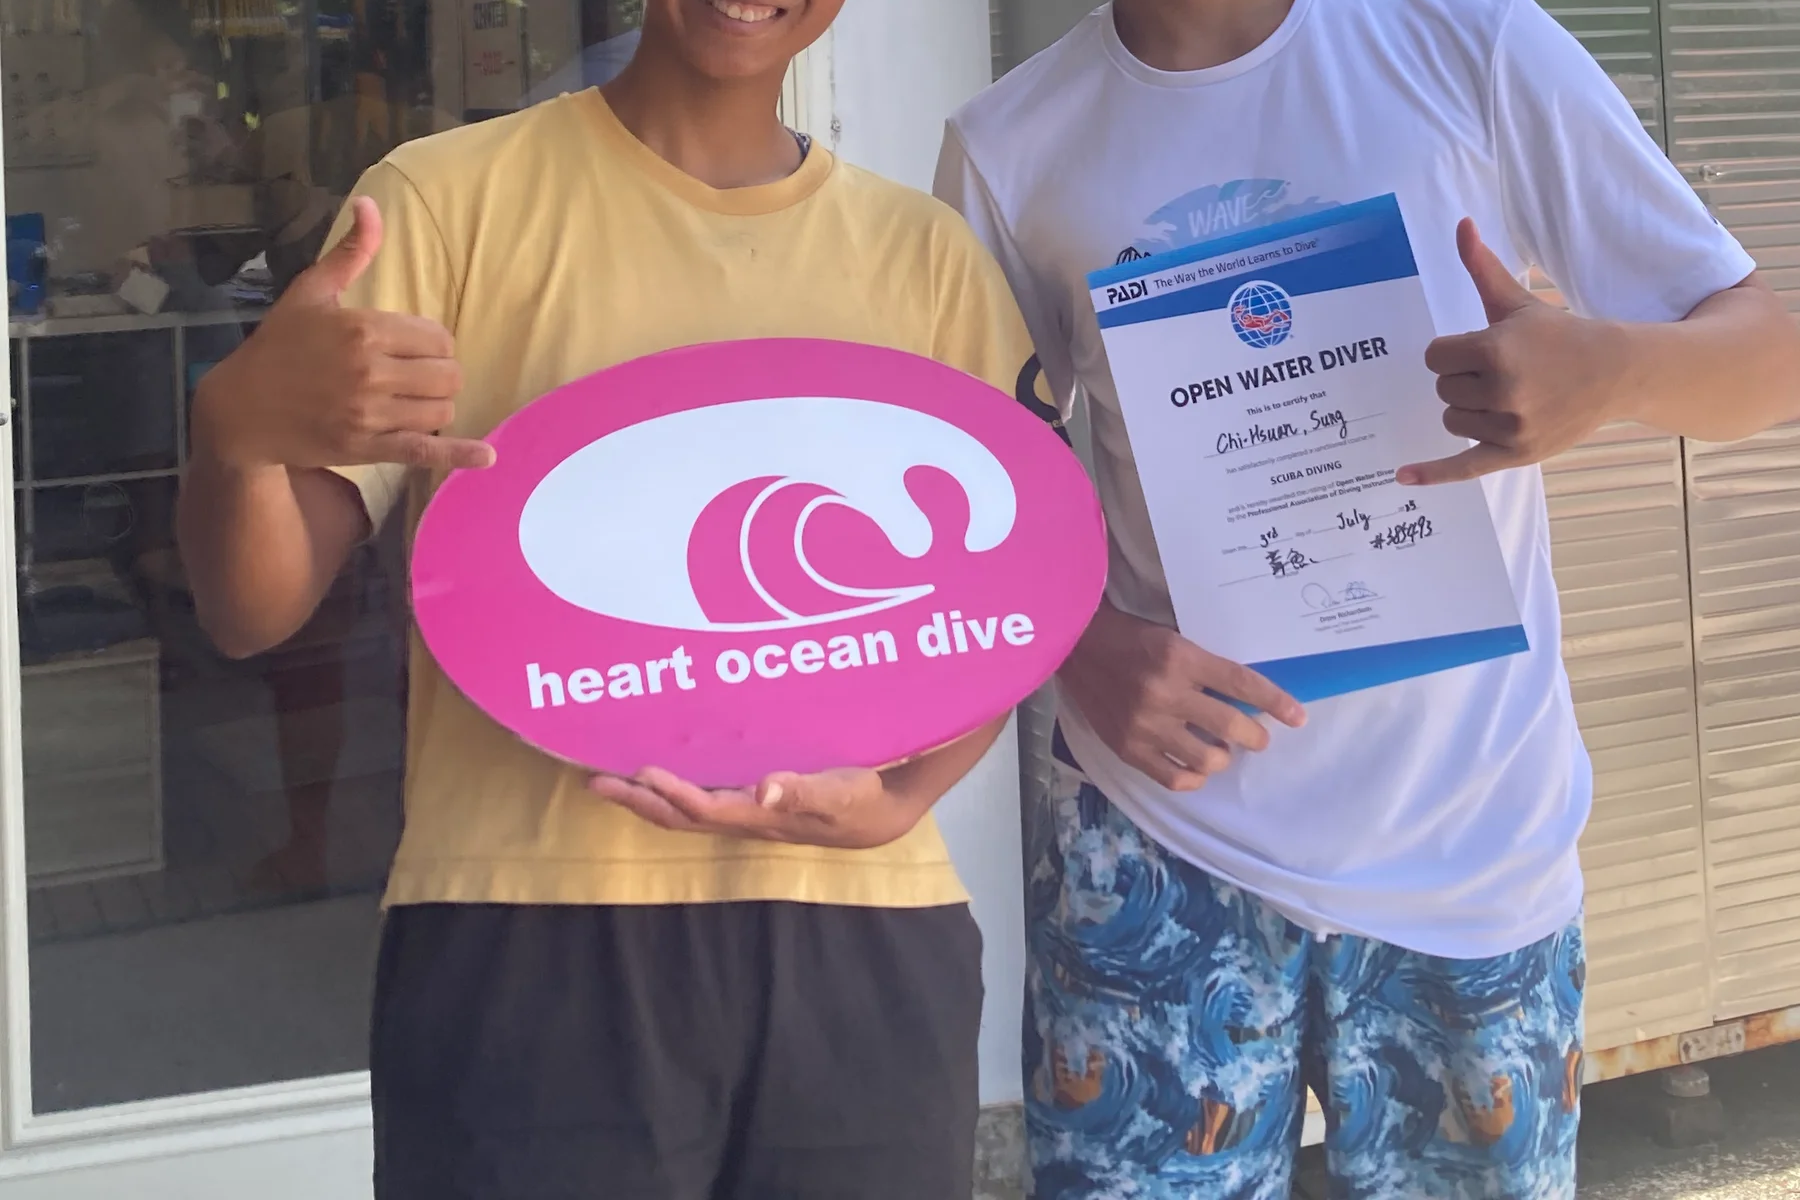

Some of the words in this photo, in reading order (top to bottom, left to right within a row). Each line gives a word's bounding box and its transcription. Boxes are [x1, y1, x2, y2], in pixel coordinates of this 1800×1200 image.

[1187, 193, 1258, 238] WAVE
[1154, 279, 1173, 289] The
[1173, 272, 1196, 285] Way
[1198, 267, 1214, 278] the
[1215, 257, 1246, 273] World
[1247, 250, 1281, 265] Learns
[1282, 246, 1293, 256] to
[1107, 280, 1148, 304] PADI
[1170, 375, 1233, 408] OPEN
[1236, 355, 1315, 391] WATER
[1319, 337, 1389, 371] DIVER
[1246, 407, 1263, 416] This
[1264, 404, 1271, 412] is
[1272, 402, 1281, 410] to
[1282, 396, 1308, 407] certify
[1309, 390, 1327, 400] that
[1310, 409, 1347, 439] Sung
[1270, 470, 1304, 485] SCUBA
[1306, 460, 1342, 476] DIVING
[1260, 526, 1279, 548] 3rd
[1336, 508, 1371, 531] July
[526, 645, 696, 708] heart
[715, 630, 898, 684] ocean
[916, 610, 1035, 659] dive
